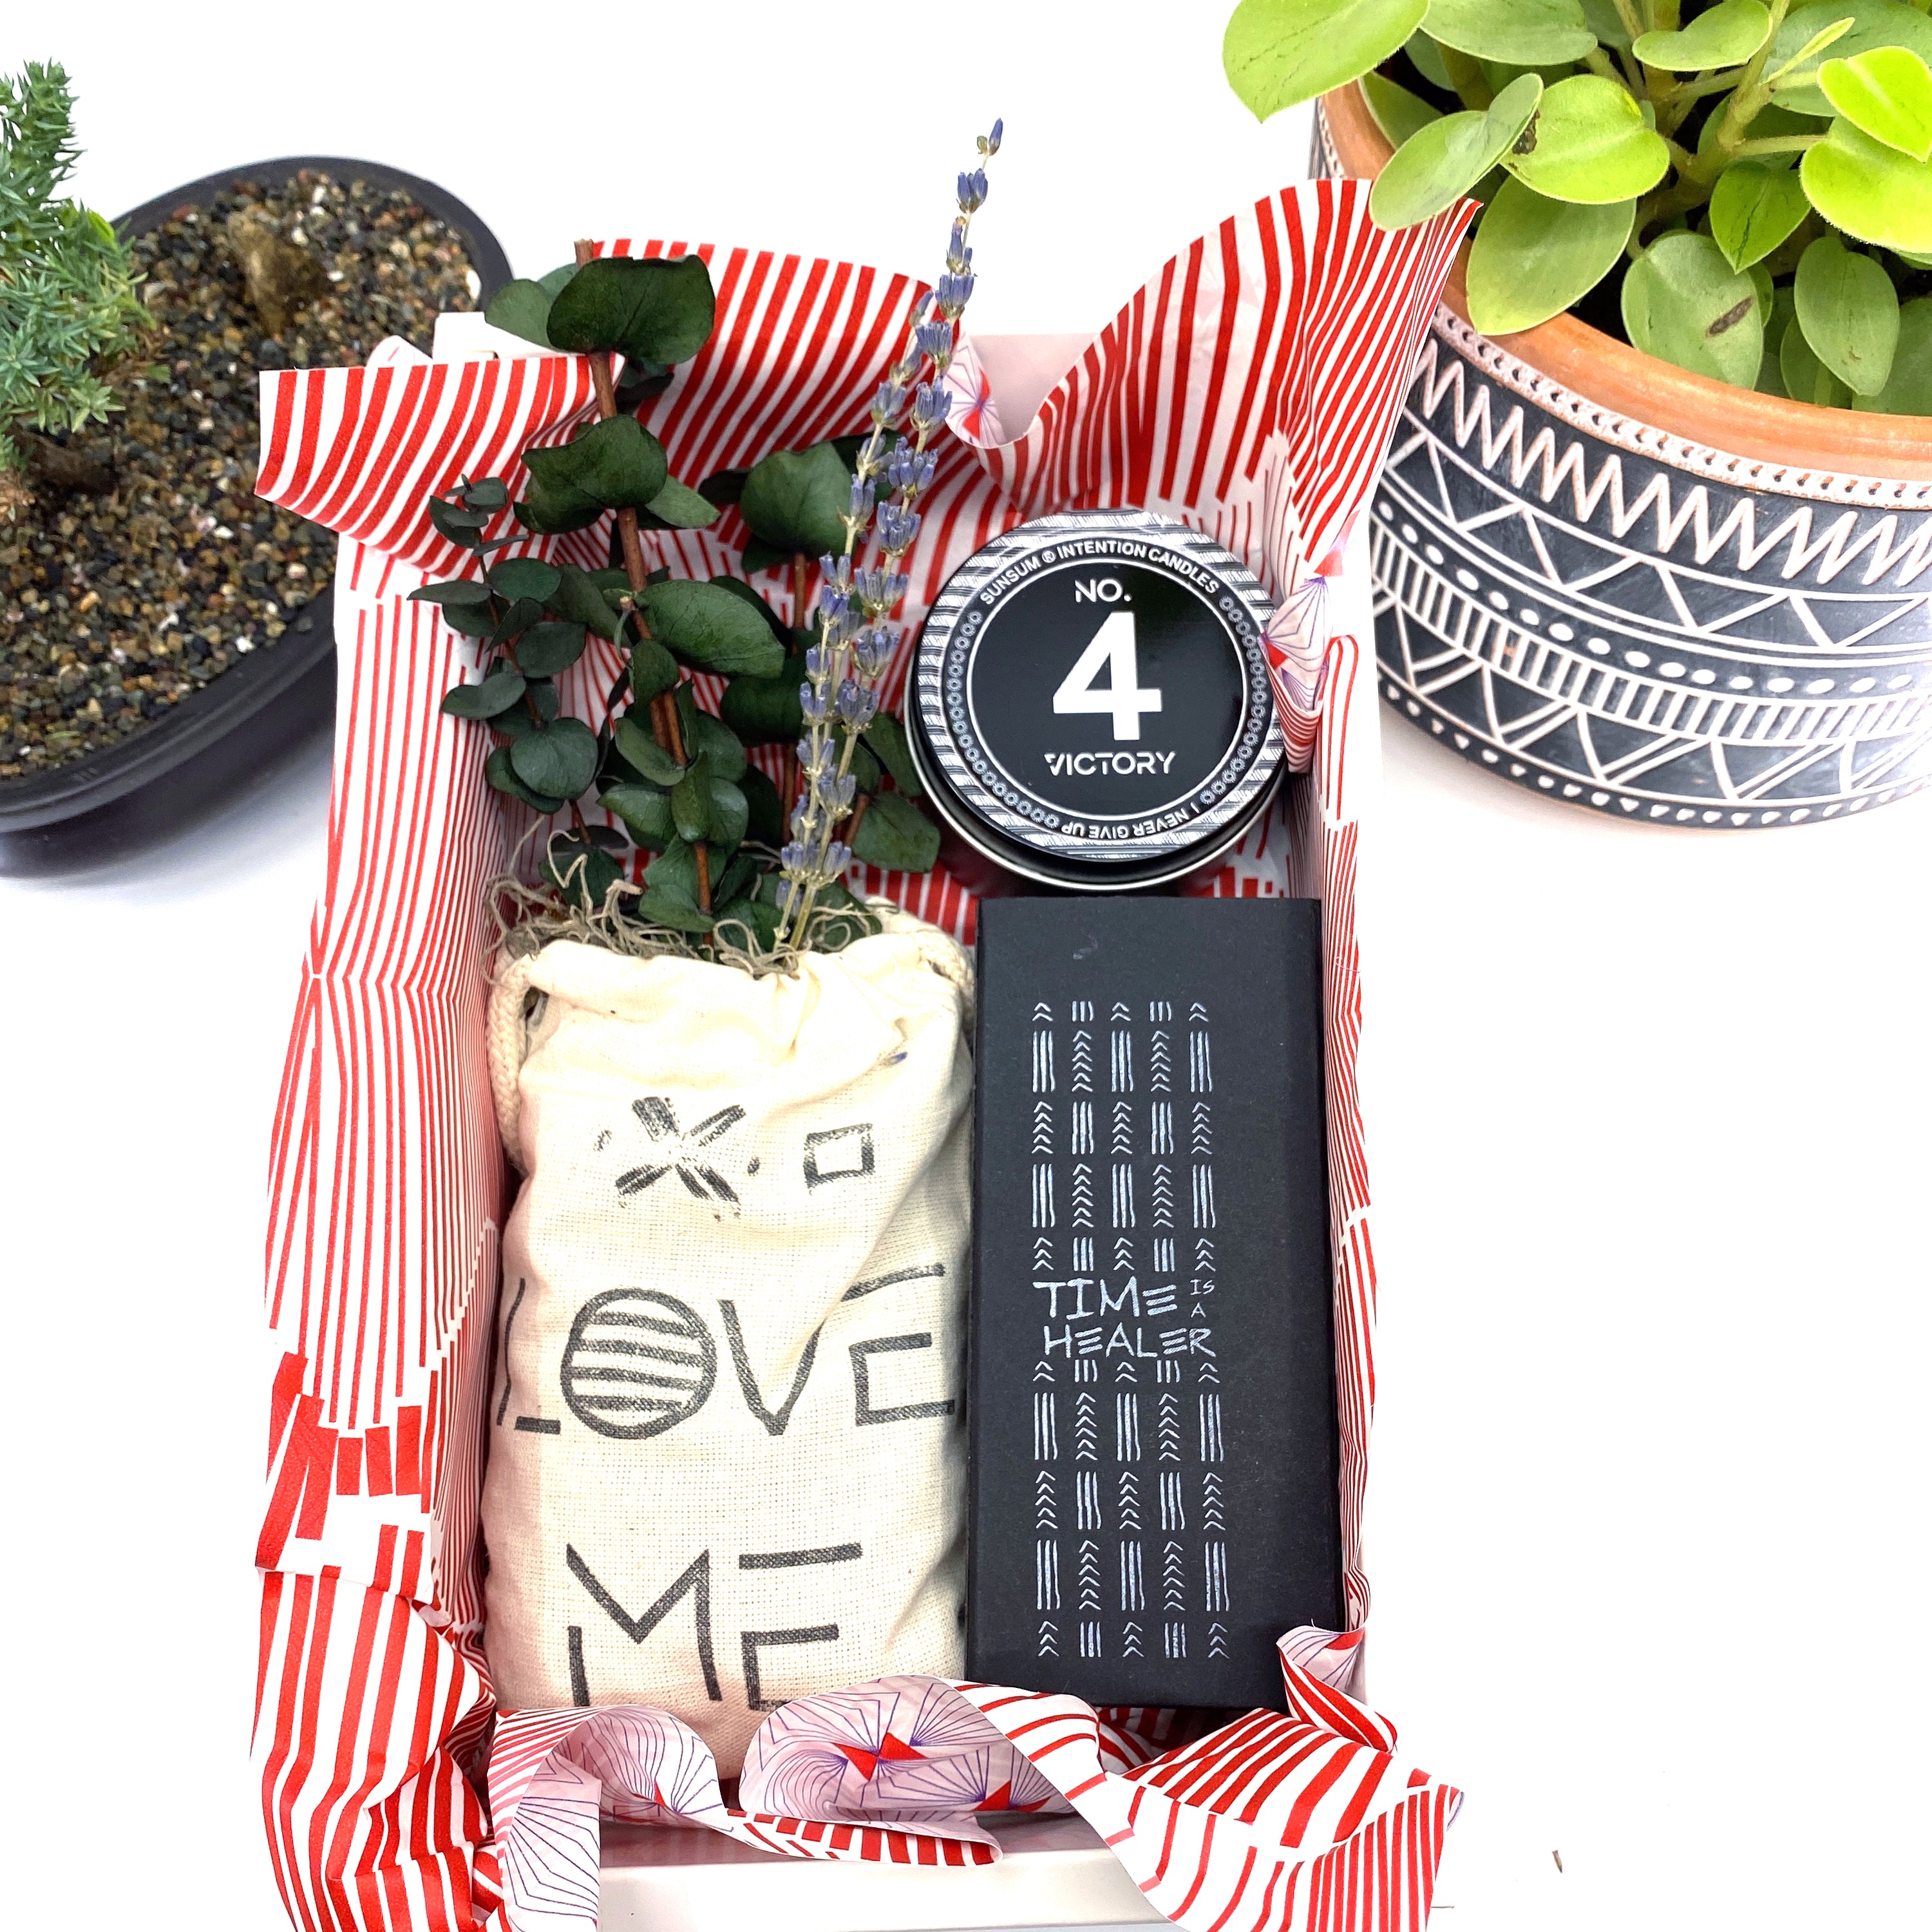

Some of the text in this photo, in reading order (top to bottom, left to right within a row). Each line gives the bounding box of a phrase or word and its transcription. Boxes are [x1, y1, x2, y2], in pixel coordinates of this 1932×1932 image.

[980, 556, 1043, 605] SUNSUM
[1057, 540, 1148, 560] INTENTION
[1148, 548, 1220, 594] CANDLES
[1074, 578, 1132, 603] NO.
[1052, 610, 1162, 741] 4
[1044, 750, 1176, 776] VICTORY
[1061, 820, 1085, 837] UP
[1088, 824, 1130, 839] GIVE
[1133, 808, 1189, 837] NEVER
[1032, 1275, 1215, 1320] TIME IS
[1190, 1302, 1213, 1318] A
[496, 1262, 955, 1439] LOVE
[1043, 1321, 1217, 1358] HEALER
[565, 1542, 863, 1710] ME
